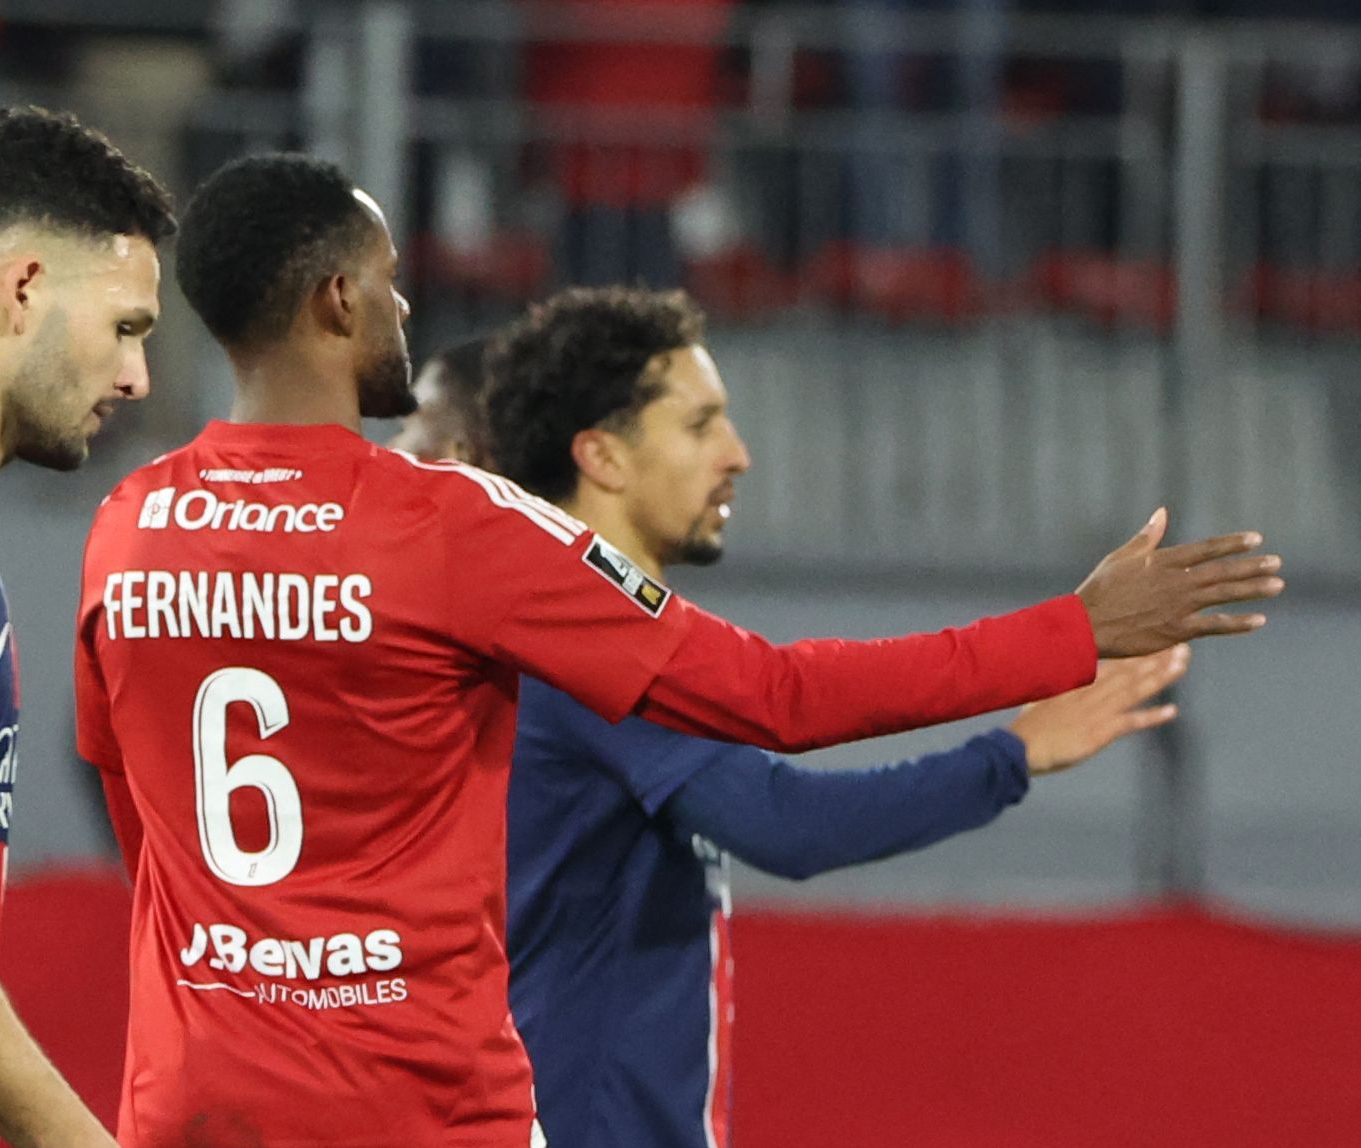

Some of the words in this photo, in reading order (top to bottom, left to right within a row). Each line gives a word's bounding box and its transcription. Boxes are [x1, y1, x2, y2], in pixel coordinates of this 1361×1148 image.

[174, 489, 344, 533] Oriance
[103, 570, 373, 643] FERNANDES
[192, 666, 304, 887] 6
